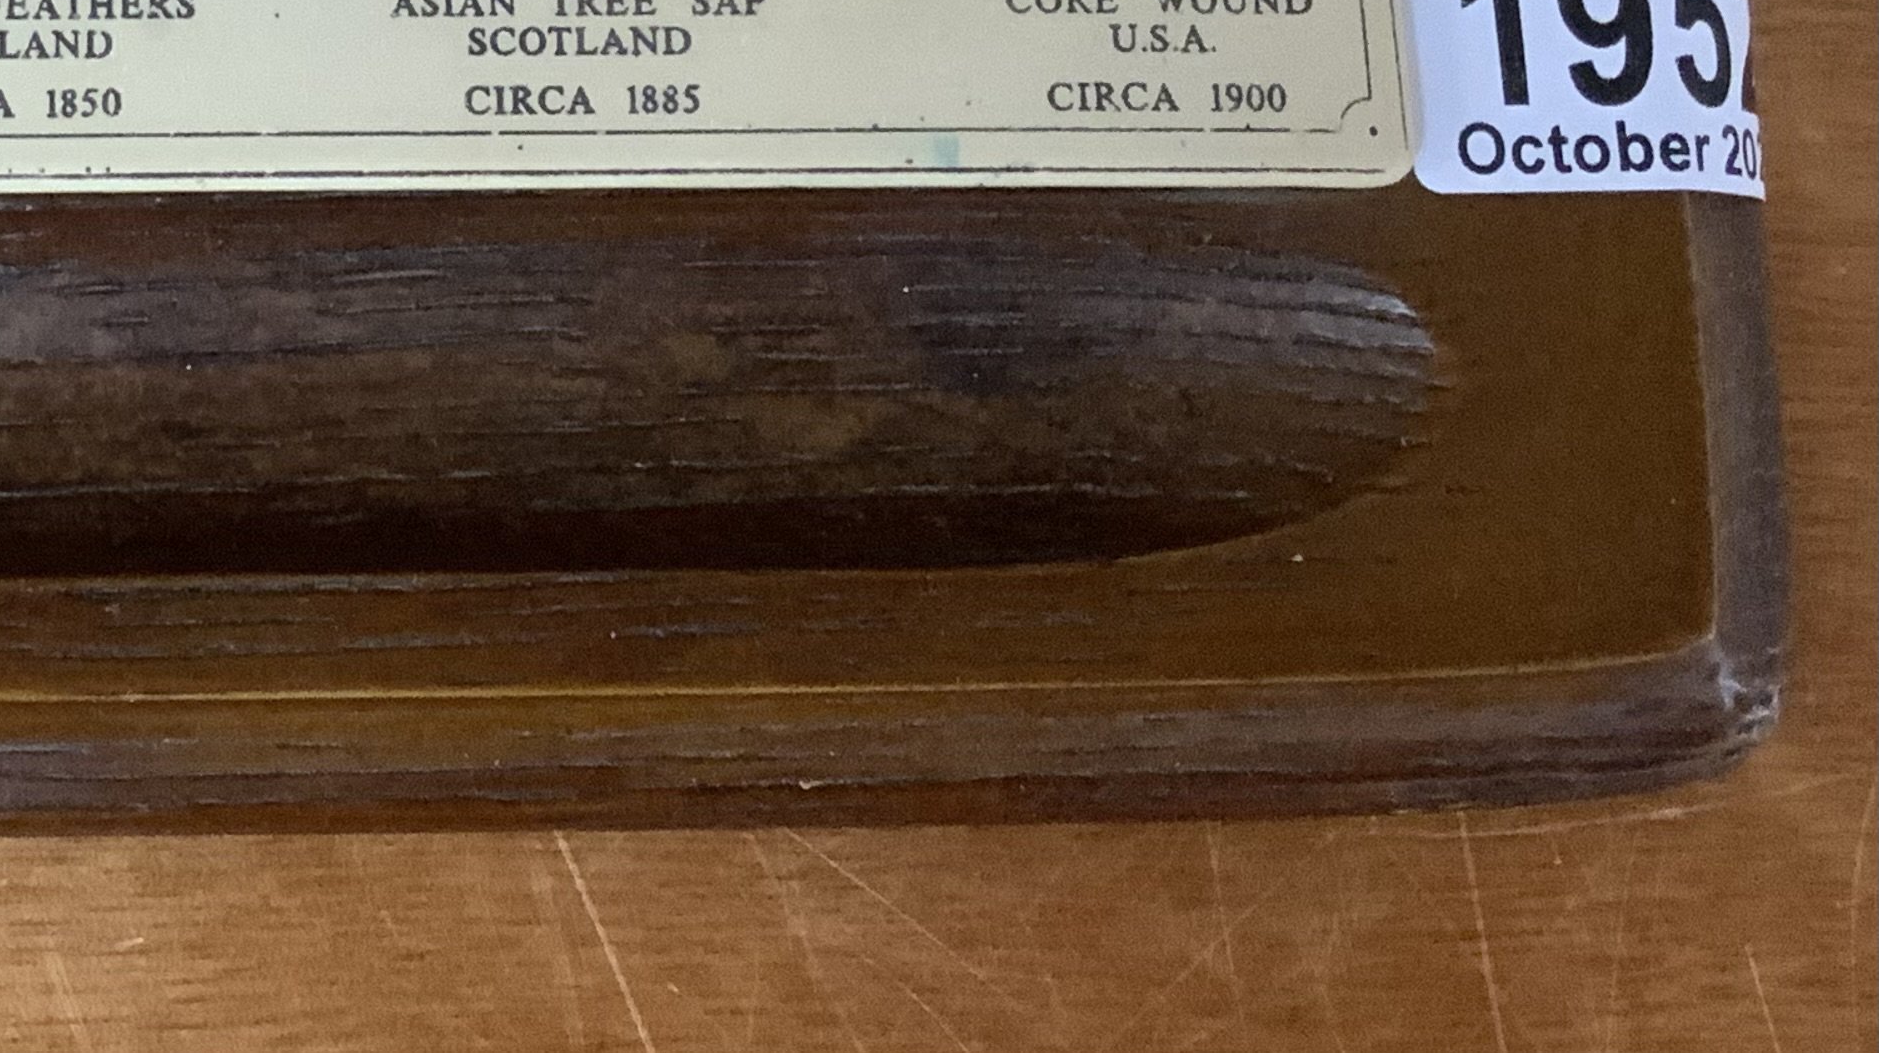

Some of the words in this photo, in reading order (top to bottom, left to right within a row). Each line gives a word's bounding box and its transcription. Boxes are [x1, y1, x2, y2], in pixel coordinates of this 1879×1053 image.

[467, 25, 692, 58] SCOTLAND
[1108, 22, 1217, 54] U.S.A.
[46, 87, 122, 119] 1850
[464, 84, 596, 116] CIRCA
[626, 83, 701, 115] 1885
[1046, 81, 1181, 113] CIRCA
[1210, 82, 1288, 113] 1900
[1457, 120, 1710, 176] October
[1721, 124, 1760, 180] 20
